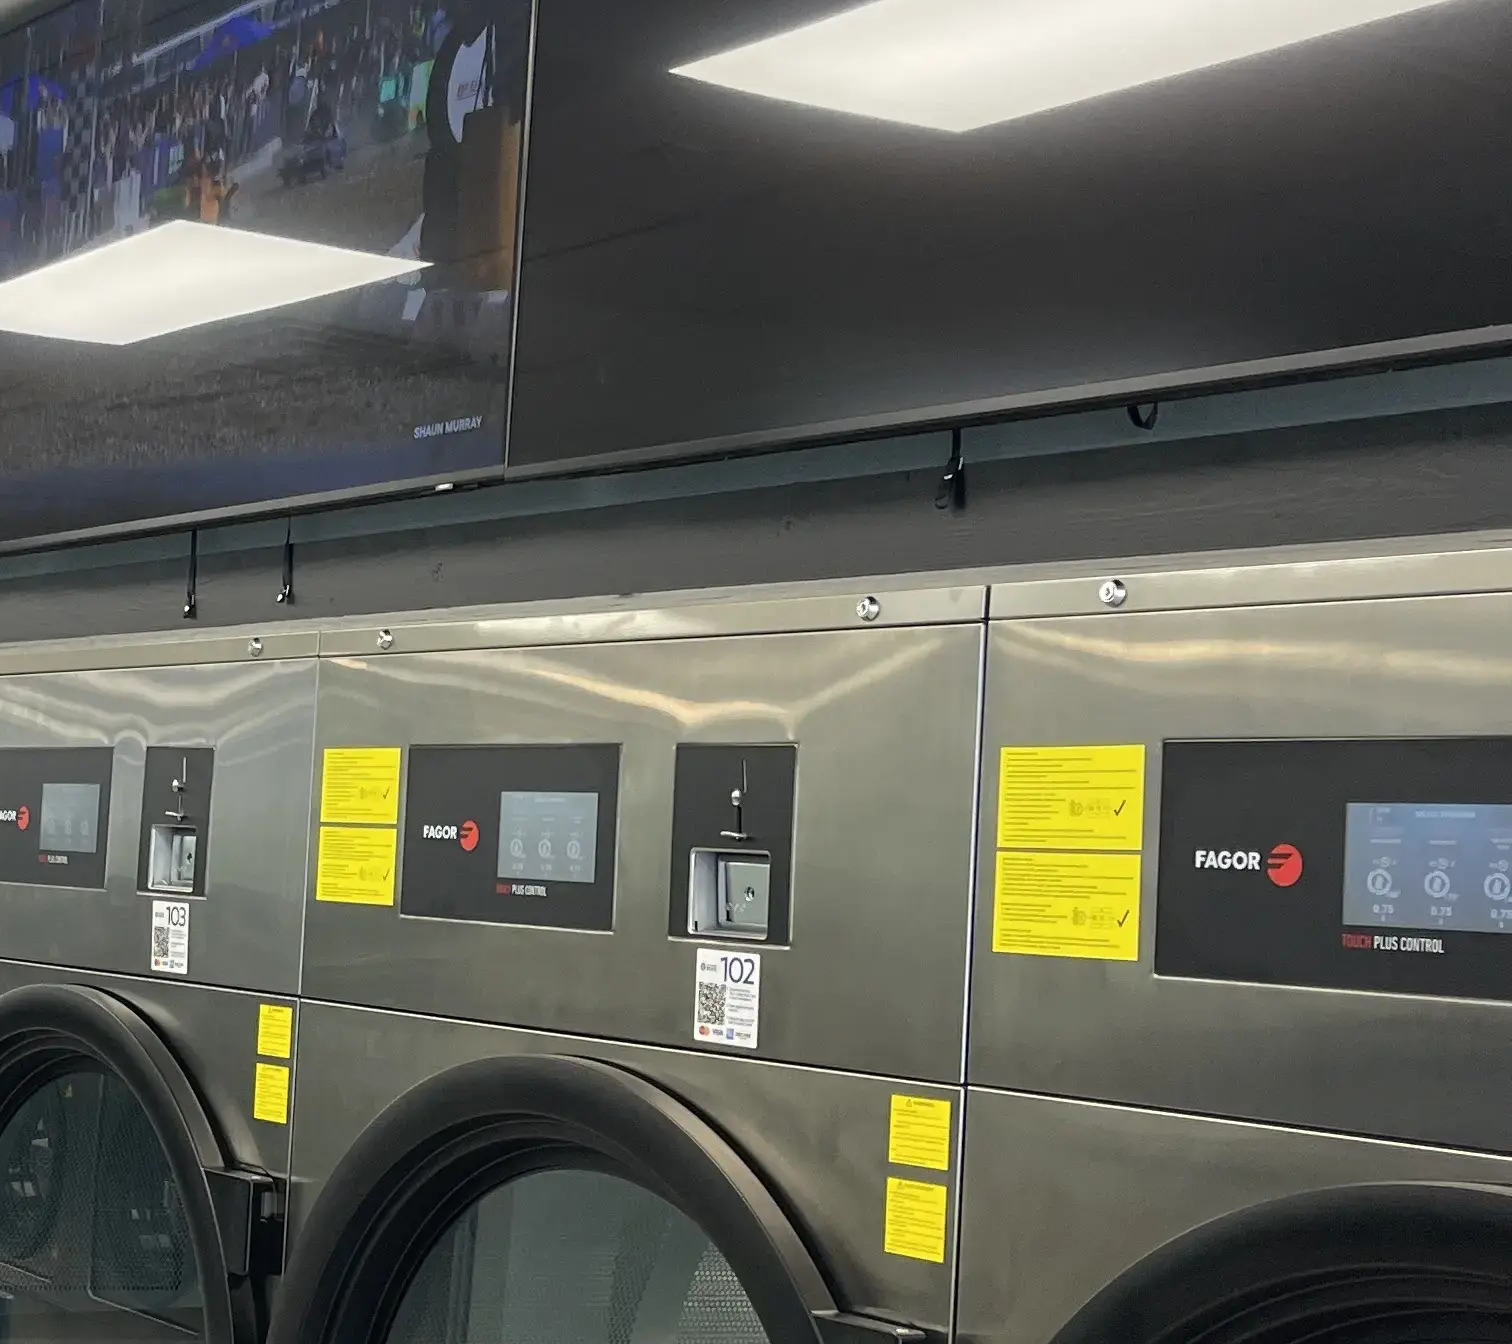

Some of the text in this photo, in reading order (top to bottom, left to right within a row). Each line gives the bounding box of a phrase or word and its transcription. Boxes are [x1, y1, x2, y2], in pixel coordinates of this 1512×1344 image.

[413, 416, 483, 439] SHAUN MURRAY
[422, 825, 458, 840] FAGOR
[1194, 850, 1261, 870] FAGOR
[166, 906, 186, 927] 103
[1373, 935, 1399, 951] PLUS
[1399, 937, 1445, 953] CONTROL
[720, 956, 756, 985] 102
